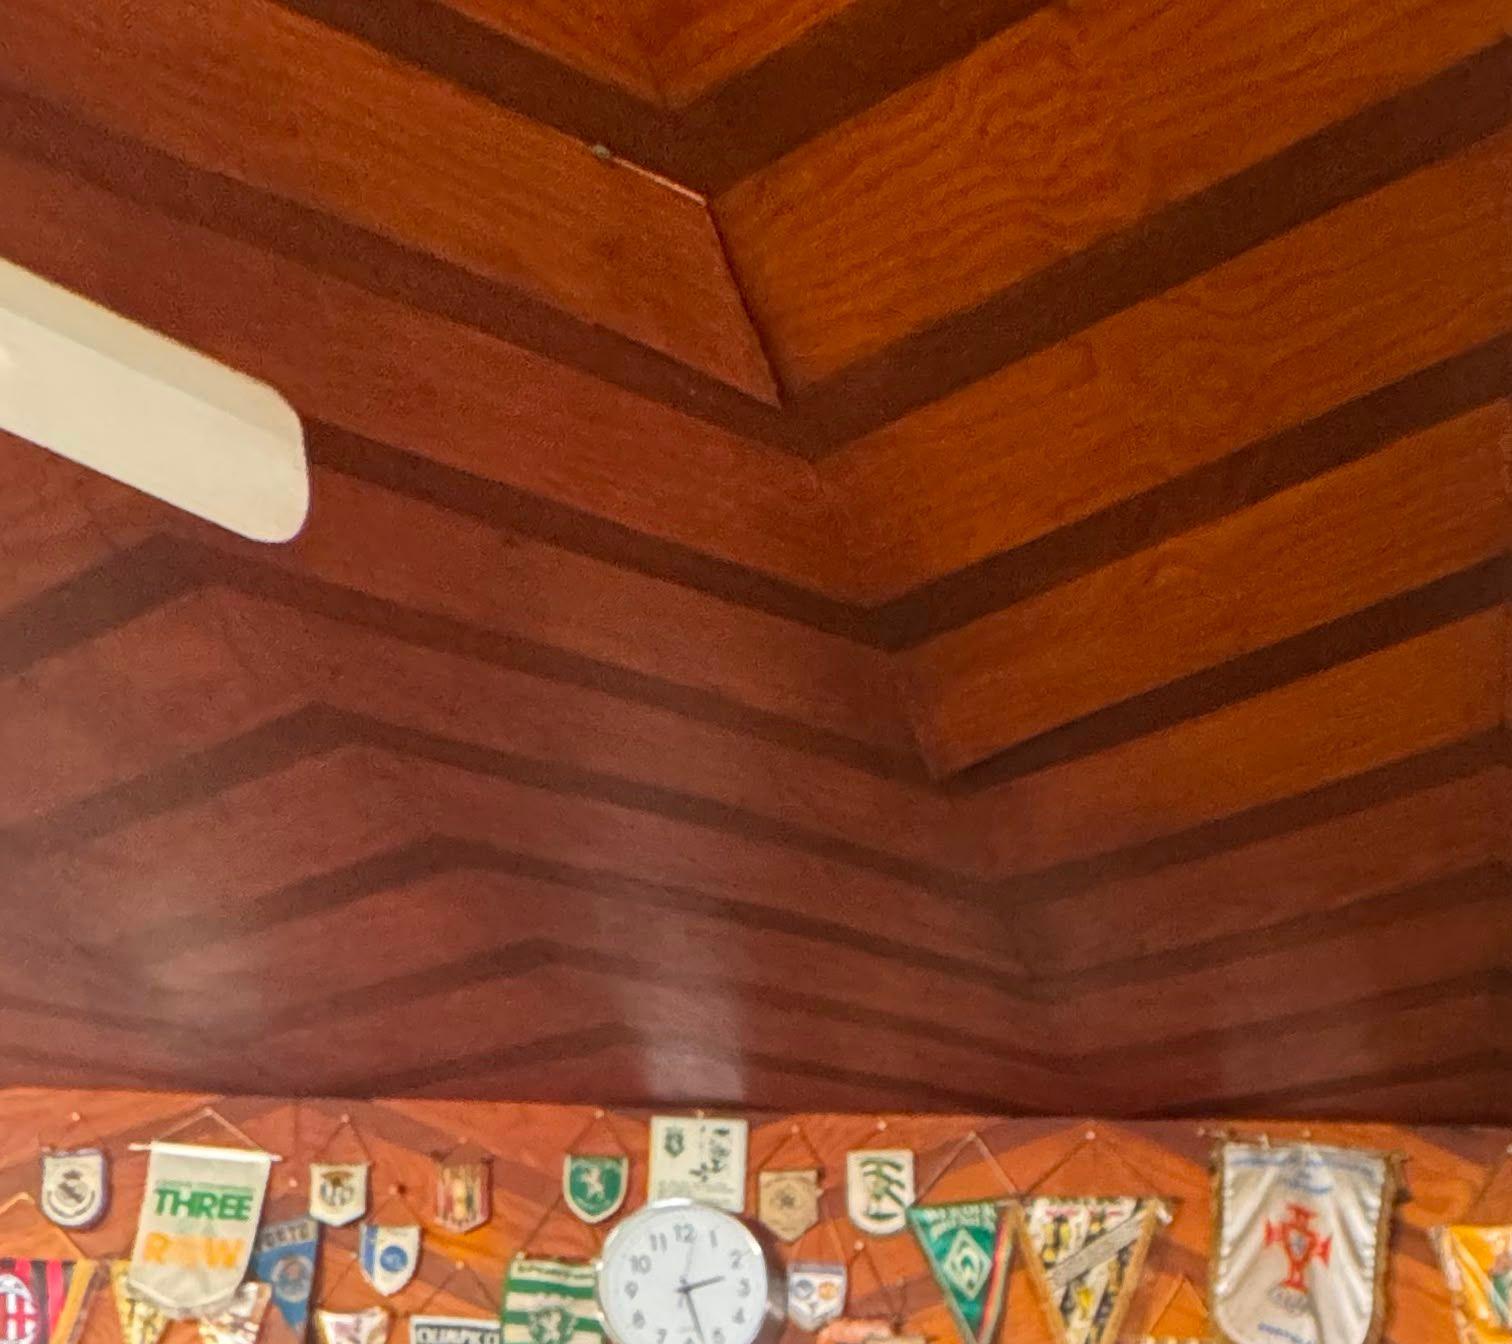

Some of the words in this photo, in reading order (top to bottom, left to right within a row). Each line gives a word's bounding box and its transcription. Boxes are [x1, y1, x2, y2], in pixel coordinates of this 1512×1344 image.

[154, 1187, 254, 1221] THREE
[650, 1231, 668, 1253] 11
[673, 1223, 697, 1243] 12
[709, 1228, 719, 1249] 1
[630, 1255, 652, 1275] 10
[728, 1248, 742, 1270] 2
[737, 1277, 752, 1298] 3
